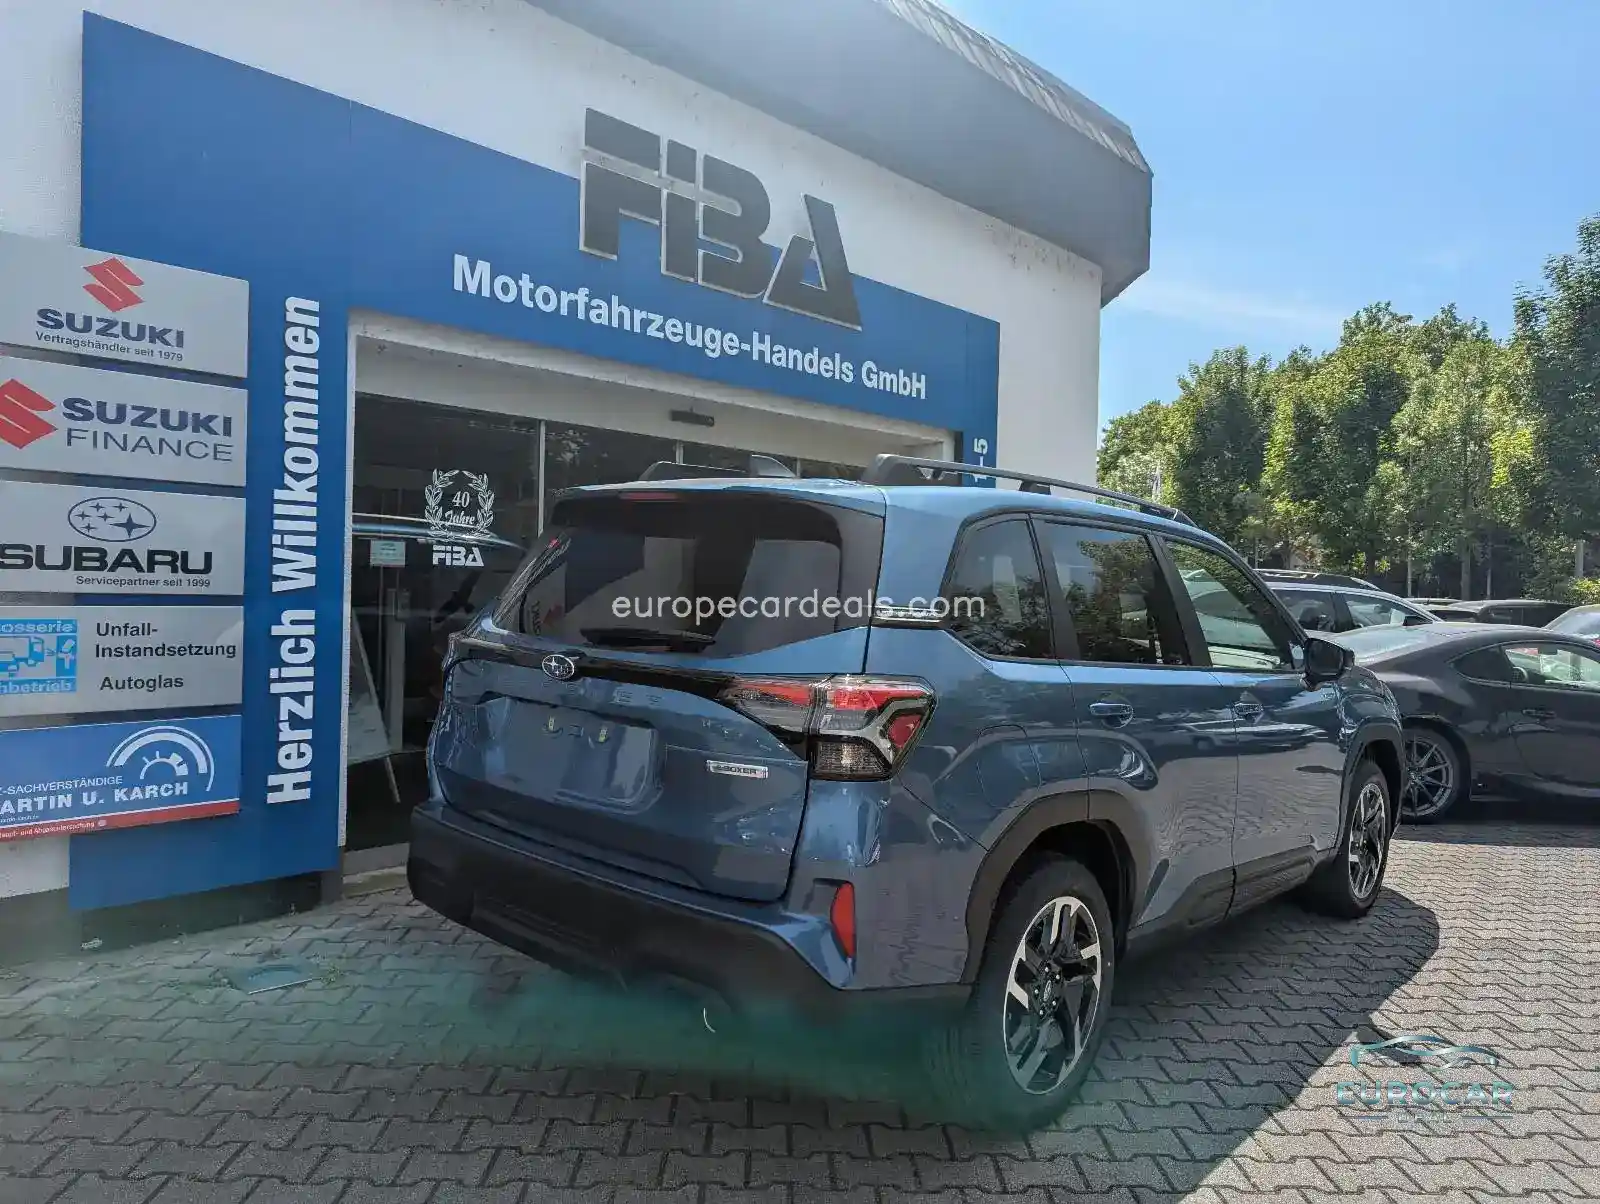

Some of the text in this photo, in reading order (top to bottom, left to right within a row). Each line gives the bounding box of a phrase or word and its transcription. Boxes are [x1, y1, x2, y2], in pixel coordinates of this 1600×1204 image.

[579, 108, 863, 331] FIBA
[36, 307, 185, 349] SUZUKI
[452, 254, 928, 400] Motorfahrzeuge-Handels GmbH
[35, 331, 184, 362] Vertragshändler seit 1979
[62, 396, 233, 438] SUZUKI
[66, 427, 234, 463] FINANCE
[452, 490, 470, 508] 40
[444, 509, 476, 526] Jahre
[0, 543, 213, 575] SUBARU
[266, 296, 321, 805] Herzlich Willkommen
[432, 544, 485, 567] FIBA
[75, 575, 212, 589] Servicepartner seit 1999
[0, 619, 74, 633] osserie
[96, 622, 158, 638] Unfall-
[95, 643, 237, 660] Instandsetzung
[99, 674, 185, 694] Autoglas
[82, 791, 105, 806] U.
[114, 781, 189, 802] KARCH
